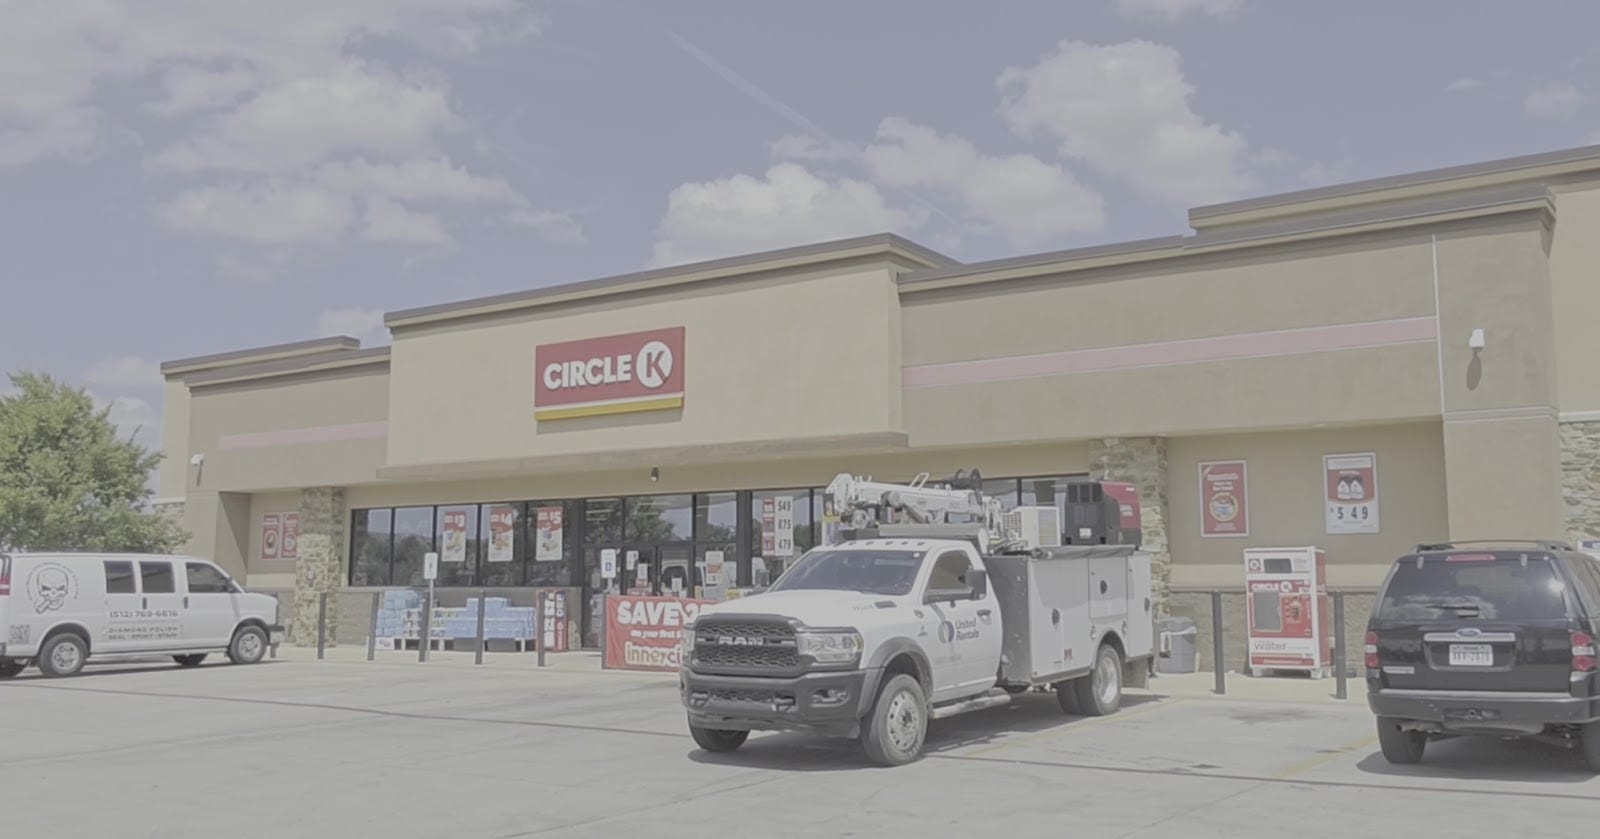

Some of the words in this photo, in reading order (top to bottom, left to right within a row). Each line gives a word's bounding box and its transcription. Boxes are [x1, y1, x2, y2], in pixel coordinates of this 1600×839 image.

[543, 354, 632, 390] CIRCLE
[645, 349, 669, 384] K
[617, 600, 681, 627] SAVE
[955, 617, 977, 629] United
[956, 629, 979, 640] Rentals
[719, 636, 763, 646] RAM
